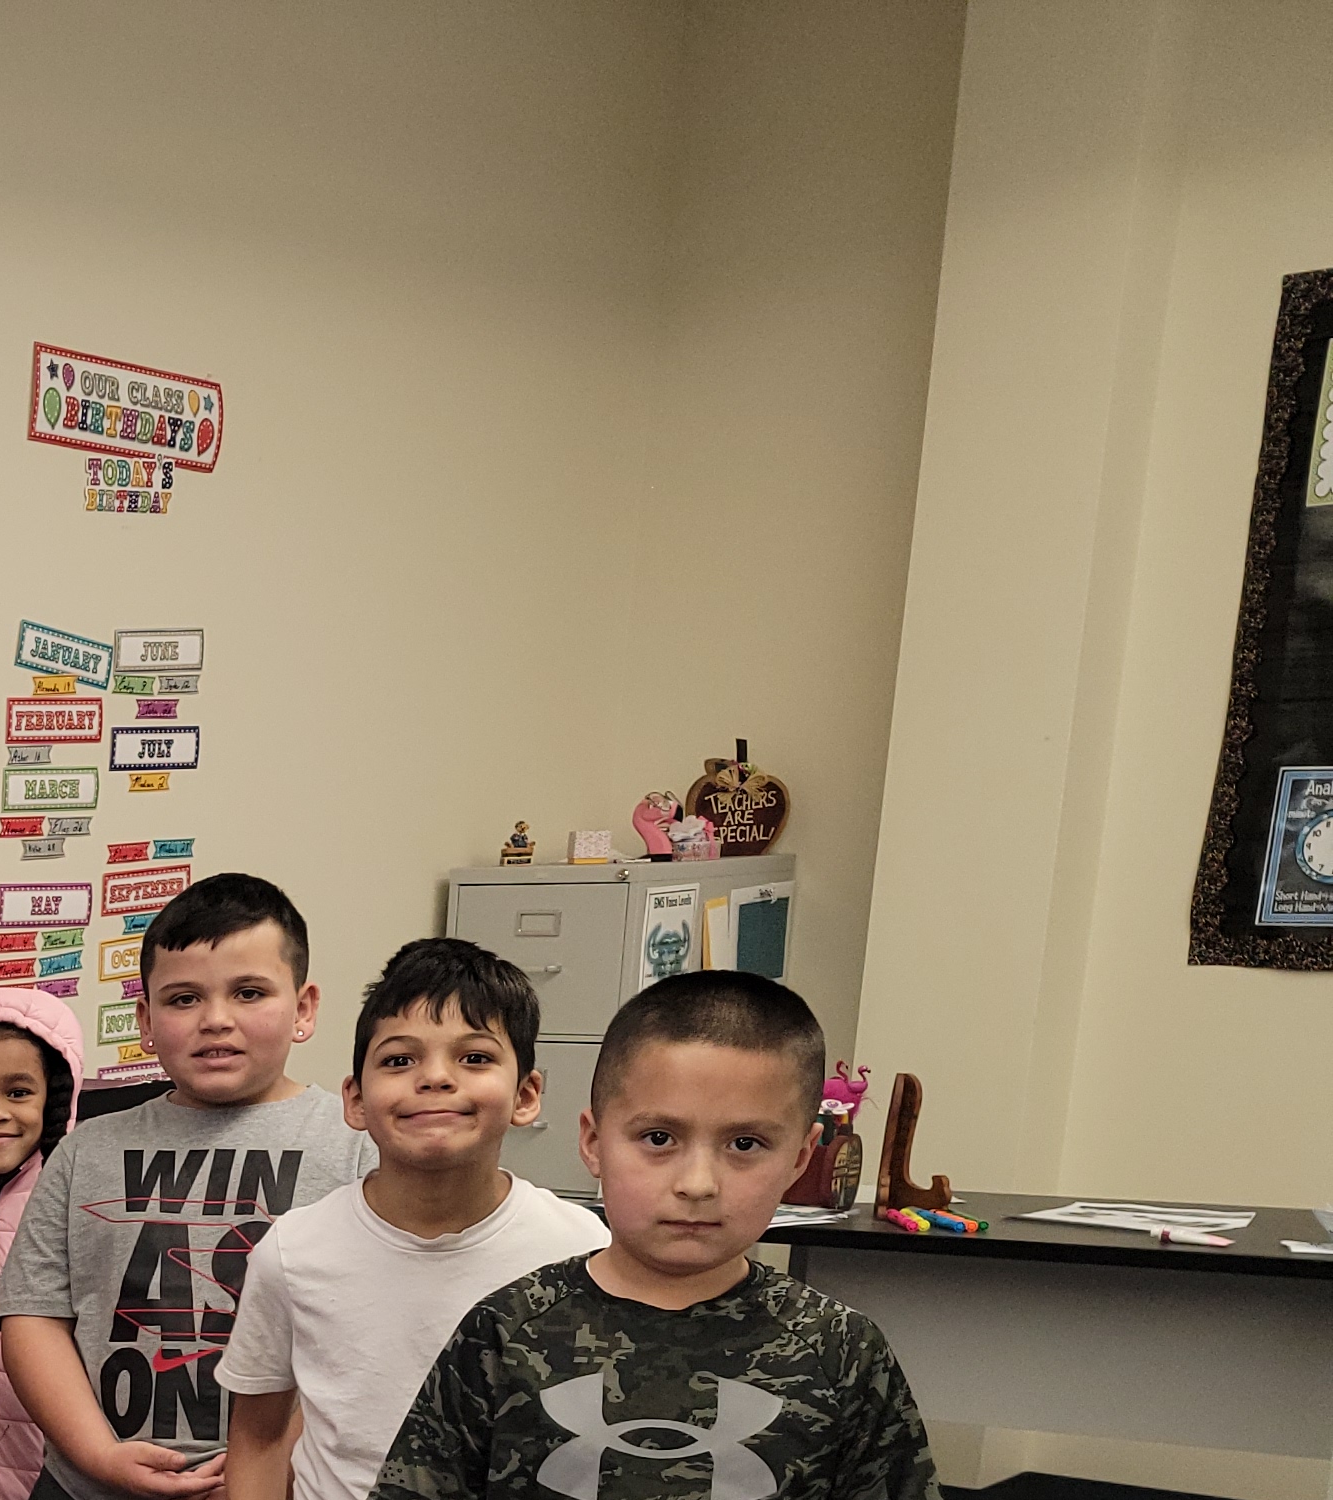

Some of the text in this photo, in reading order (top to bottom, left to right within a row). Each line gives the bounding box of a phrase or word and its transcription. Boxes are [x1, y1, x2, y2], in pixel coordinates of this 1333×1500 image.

[80, 370, 184, 415] OUR CLASS
[63, 396, 195, 452] BIRTHDAYS
[88, 453, 173, 489] TODAY'S
[86, 489, 172, 514] BIRTHDAY
[30, 636, 102, 674] JANUARY
[140, 641, 179, 661] JUNE
[15, 711, 96, 731] FEBRUARY
[138, 739, 174, 758] JULY
[24, 779, 80, 799] MARCH
[723, 810, 754, 826] ARE
[109, 878, 184, 903] SEPTEMBER
[31, 896, 62, 915] MAY
[124, 1149, 303, 1216] WIN
[100, 1347, 233, 1441] ON
